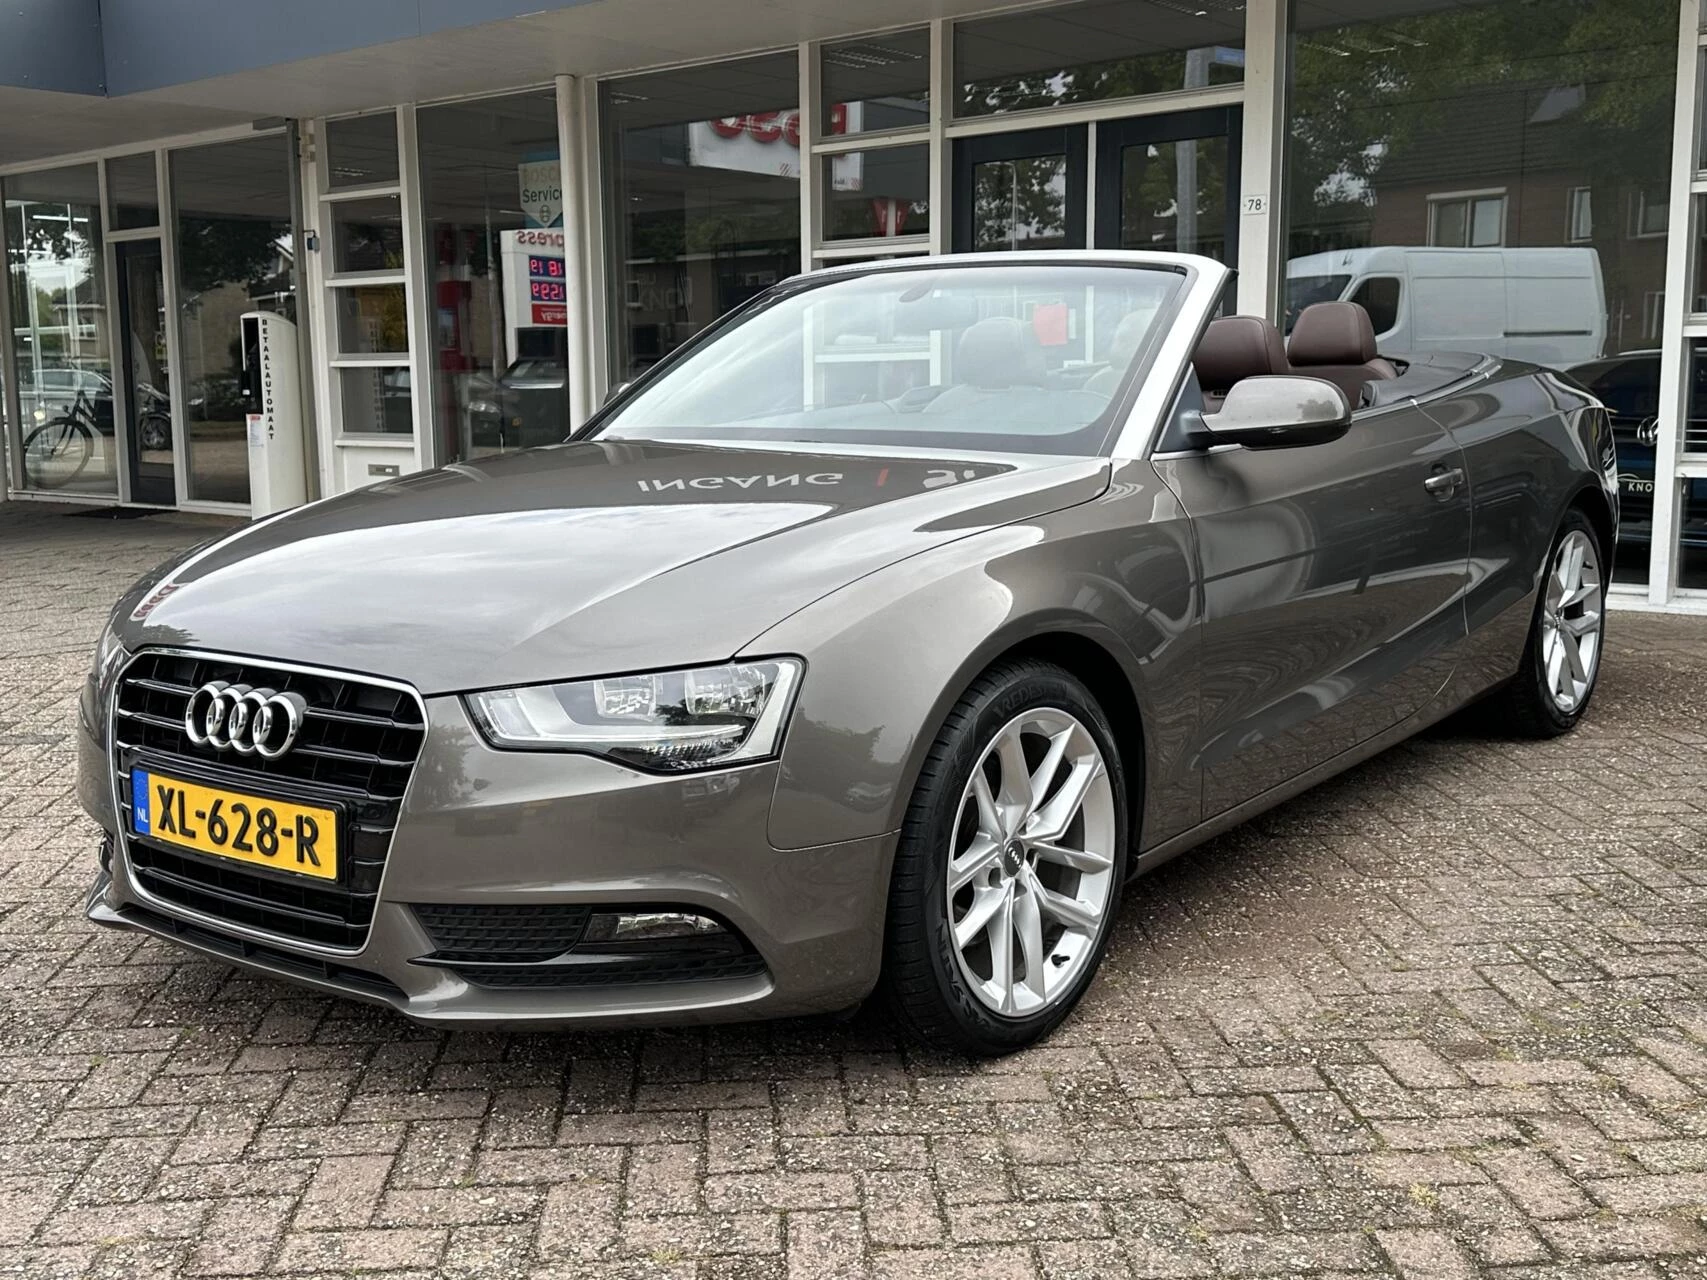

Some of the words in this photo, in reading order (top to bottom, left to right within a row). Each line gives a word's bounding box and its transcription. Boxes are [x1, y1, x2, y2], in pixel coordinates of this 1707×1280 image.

[522, 185, 562, 204] Servic
[1248, 199, 1261, 210] 78
[262, 319, 274, 440] BETAALAUTOMAAT
[1628, 483, 1653, 492] KNO
[137, 808, 149, 823] NL
[157, 784, 321, 867] XL-628-R
